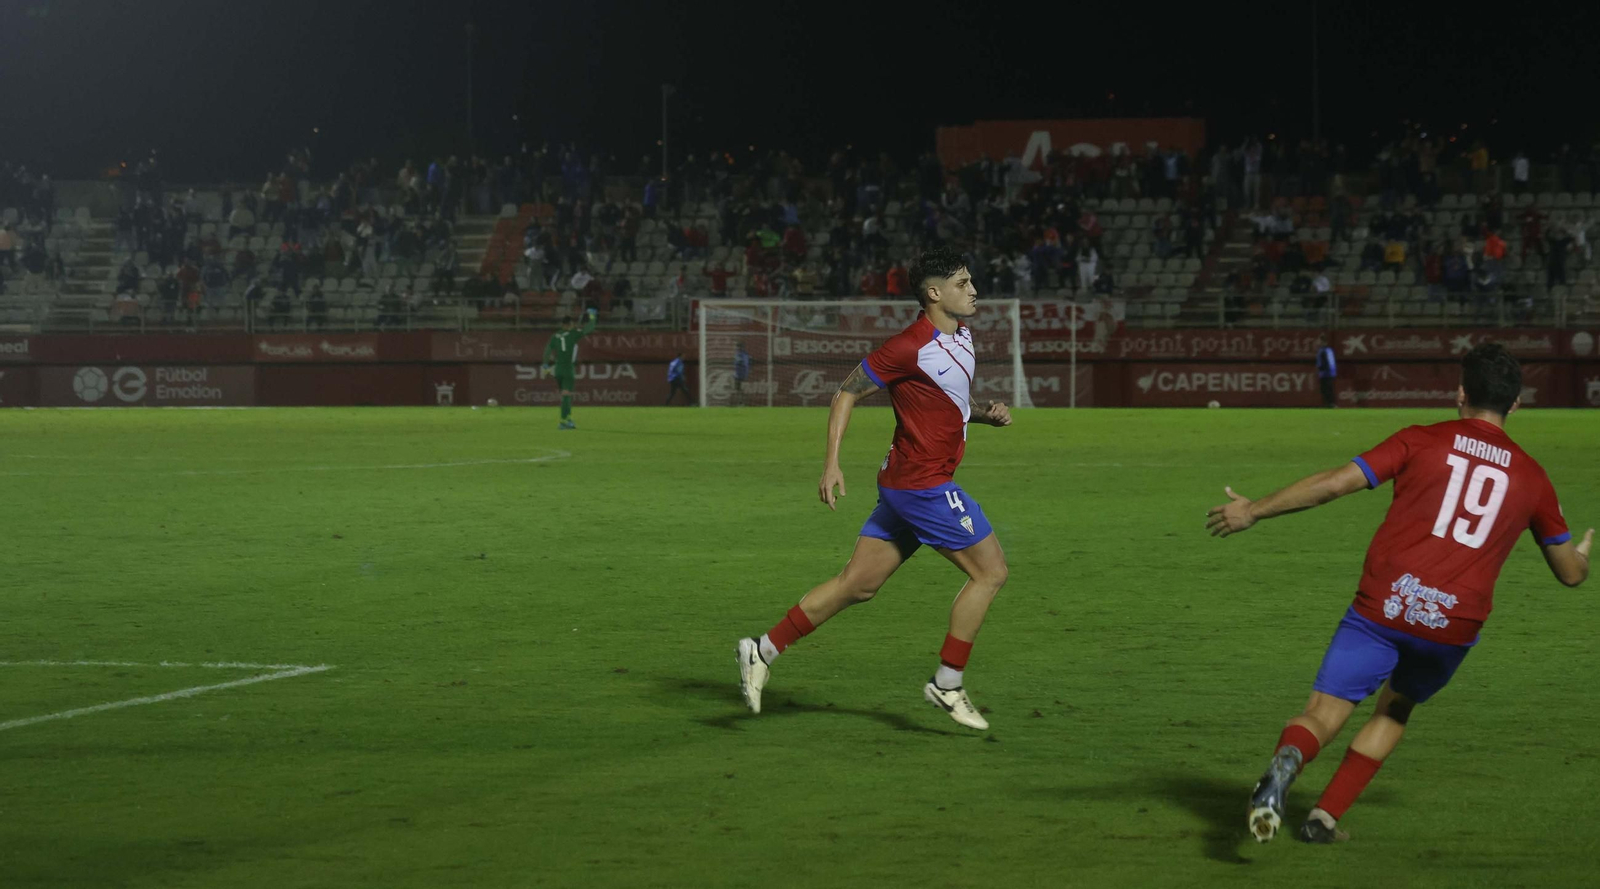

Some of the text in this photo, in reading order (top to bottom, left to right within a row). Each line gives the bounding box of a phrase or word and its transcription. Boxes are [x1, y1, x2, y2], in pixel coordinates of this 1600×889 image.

[514, 364, 639, 380] SKDA
[1157, 372, 1306, 392] CAPENERGY
[156, 385, 223, 399] Emotion
[592, 389, 639, 402] Motor
[1453, 434, 1512, 468] MARINO
[944, 490, 966, 513] 4
[1431, 453, 1510, 549] 19
